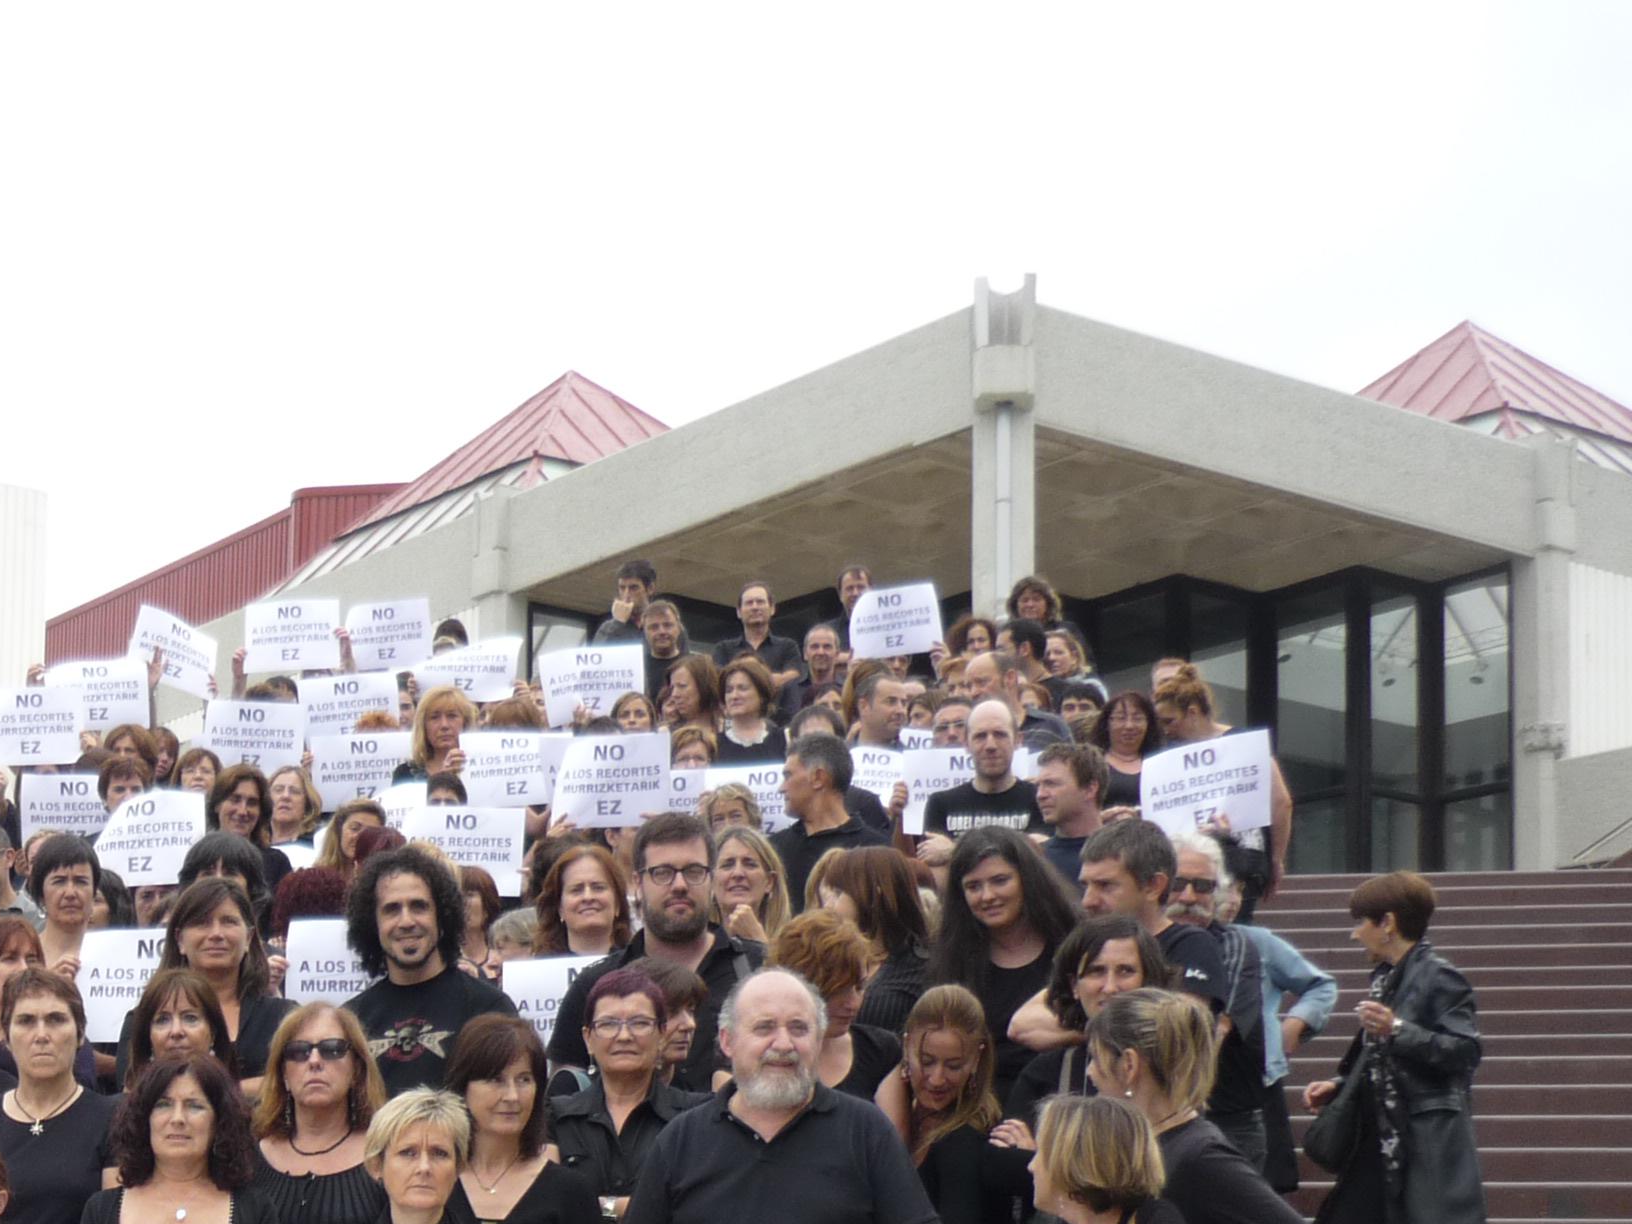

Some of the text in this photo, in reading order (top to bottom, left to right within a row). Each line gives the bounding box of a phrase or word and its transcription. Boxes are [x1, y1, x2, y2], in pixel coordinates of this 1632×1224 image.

[878, 594, 902, 609] NO
[277, 606, 302, 619] NO
[372, 607, 395, 621] NO
[864, 613, 881, 624] LOS
[882, 606, 930, 621] RECORTES
[170, 622, 192, 641] NO
[260, 625, 278, 634] LOS
[280, 622, 331, 633] RECORTES
[357, 626, 374, 635] LOS
[375, 621, 423, 634] RECORTES
[141, 631, 211, 663] A LOS RECORTES
[885, 635, 904, 649] EZ
[281, 648, 300, 661] EZ
[378, 648, 396, 660] EZ
[576, 653, 603, 666] NO
[82, 666, 108, 678] NO
[163, 663, 184, 679] EZ
[549, 669, 634, 685] A LOS RECORTES
[87, 680, 139, 690] RECORTES
[333, 681, 359, 695] NO
[454, 678, 474, 691] EZ
[16, 694, 43, 708] NO
[316, 701, 335, 711] LOS
[337, 697, 390, 710] RECORTES
[582, 697, 601, 710] EZ
[19, 712, 75, 723] RECORTES
[89, 708, 109, 721] EZ
[239, 709, 265, 722] NO
[220, 727, 239, 735] LOS
[241, 727, 295, 738] RECORTES
[20, 741, 41, 754] EZ
[211, 738, 294, 750] MURRIZKETARIK
[351, 740, 378, 754] NO
[501, 738, 529, 749] NO
[593, 744, 625, 761] NO
[241, 754, 261, 767] EZ
[320, 762, 328, 771] A
[331, 761, 352, 771] LOS
[469, 757, 477, 766] A
[480, 755, 501, 765] LOS
[862, 754, 891, 765] NO
[1183, 748, 1216, 771] NO
[321, 771, 392, 783] MURRIZKETA
[470, 765, 543, 778] MURRIZKETA
[563, 765, 661, 780] A LOS RECORTES
[748, 771, 778, 786] NO
[913, 778, 922, 788] A
[926, 778, 949, 788] LOS
[1150, 764, 1259, 797] A LOS RECORTES
[60, 782, 89, 796] NO
[356, 786, 377, 799] EZ
[506, 781, 528, 795] EZ
[562, 780, 661, 794] MURRIZKETARIK
[1152, 781, 1259, 812] MURRIZKETARIK
[29, 802, 37, 811] A
[40, 802, 61, 811] LOS
[126, 800, 155, 818] NO
[597, 800, 622, 816] EZ
[446, 814, 477, 830] NO
[1194, 807, 1217, 826] EZ
[127, 821, 193, 835] RECORTES
[448, 836, 512, 847] RECORTES
[128, 856, 153, 873] EZ
[299, 960, 310, 973] A
[316, 960, 346, 973] LOS
[90, 968, 101, 980] A
[106, 968, 135, 981] LOS
[518, 1000, 530, 1012] A
